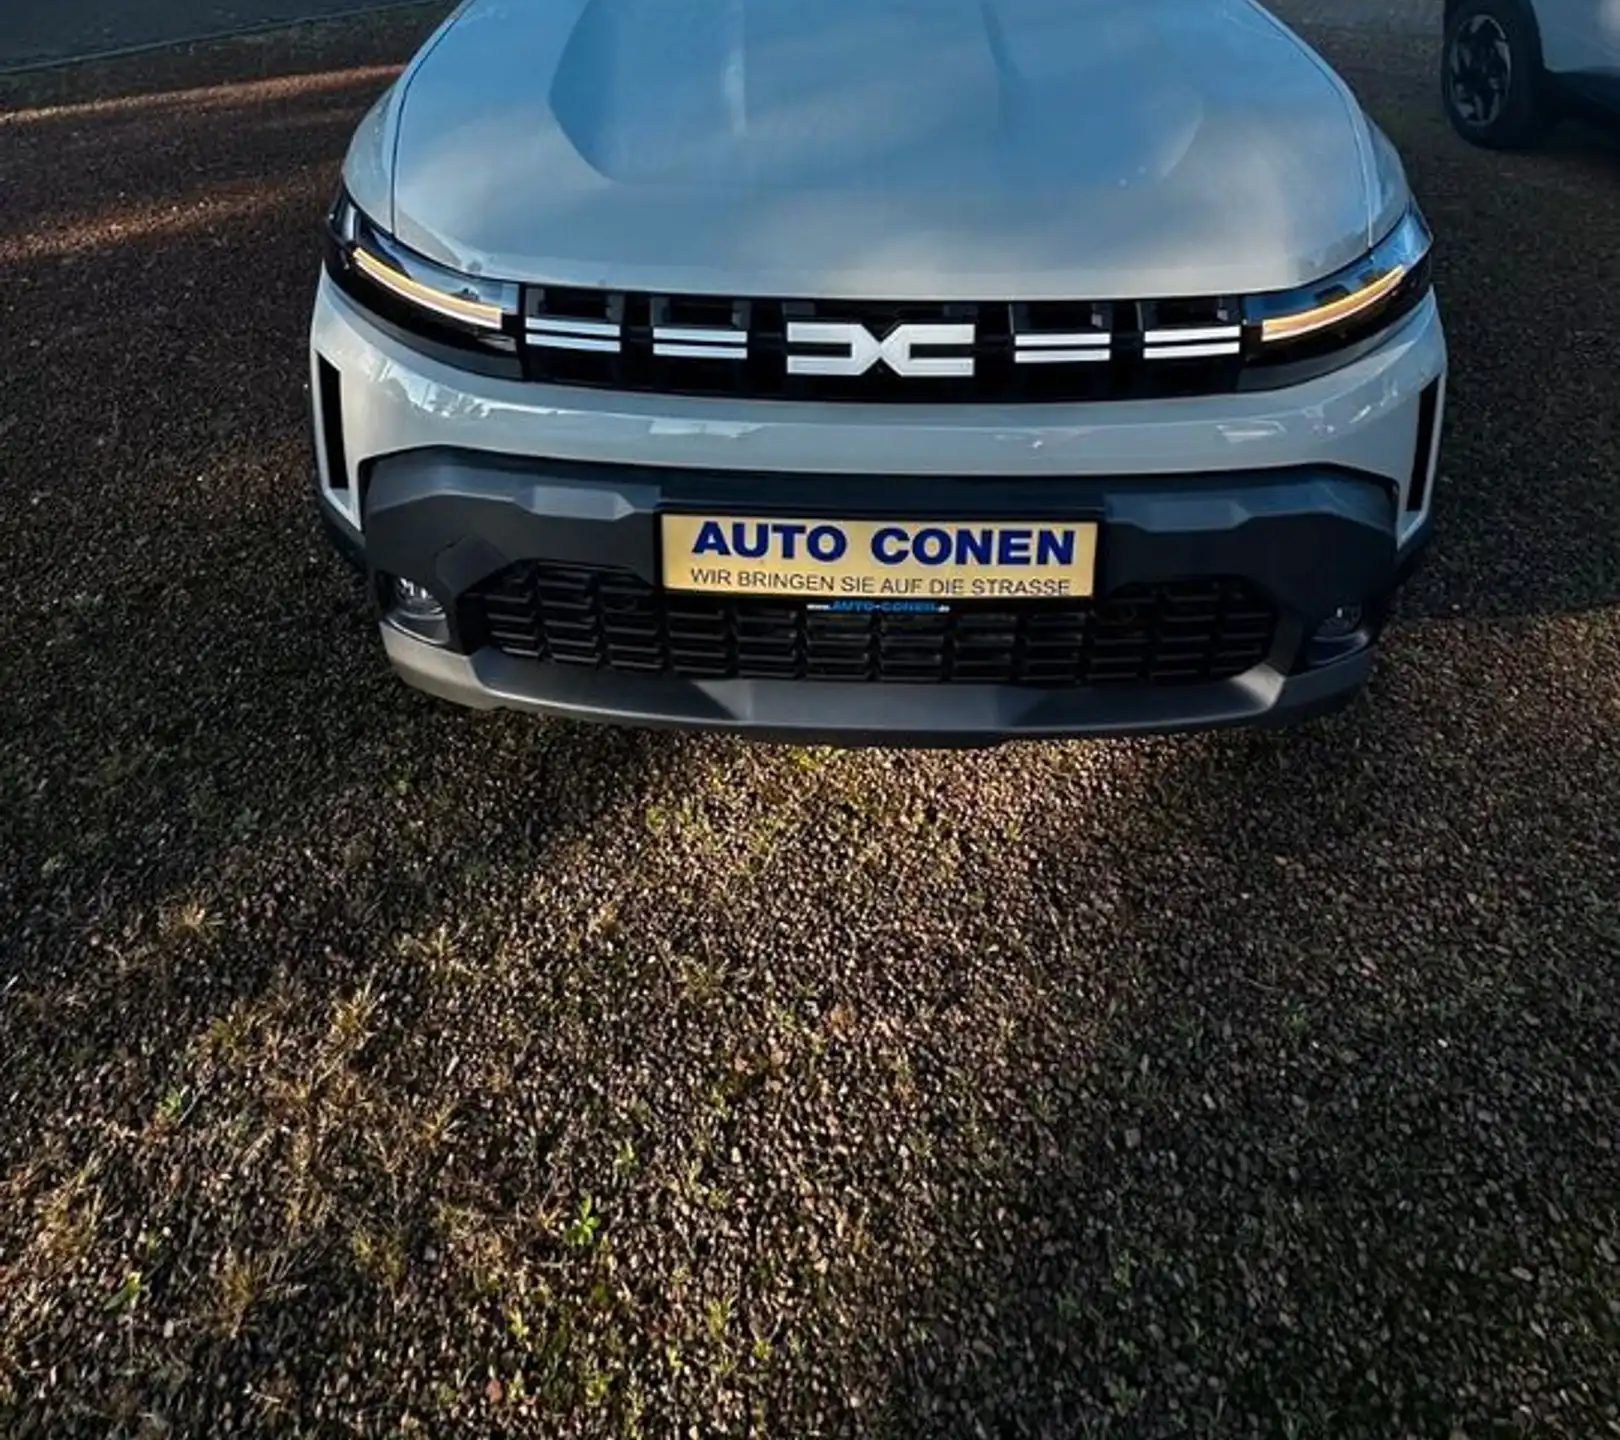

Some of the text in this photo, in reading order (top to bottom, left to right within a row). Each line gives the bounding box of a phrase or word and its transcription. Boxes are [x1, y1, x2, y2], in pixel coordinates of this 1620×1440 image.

[692, 521, 1075, 566] AUTO CONEN
[691, 568, 1070, 596] WIR BRINGEN SIE AUF DIE STRASSE
